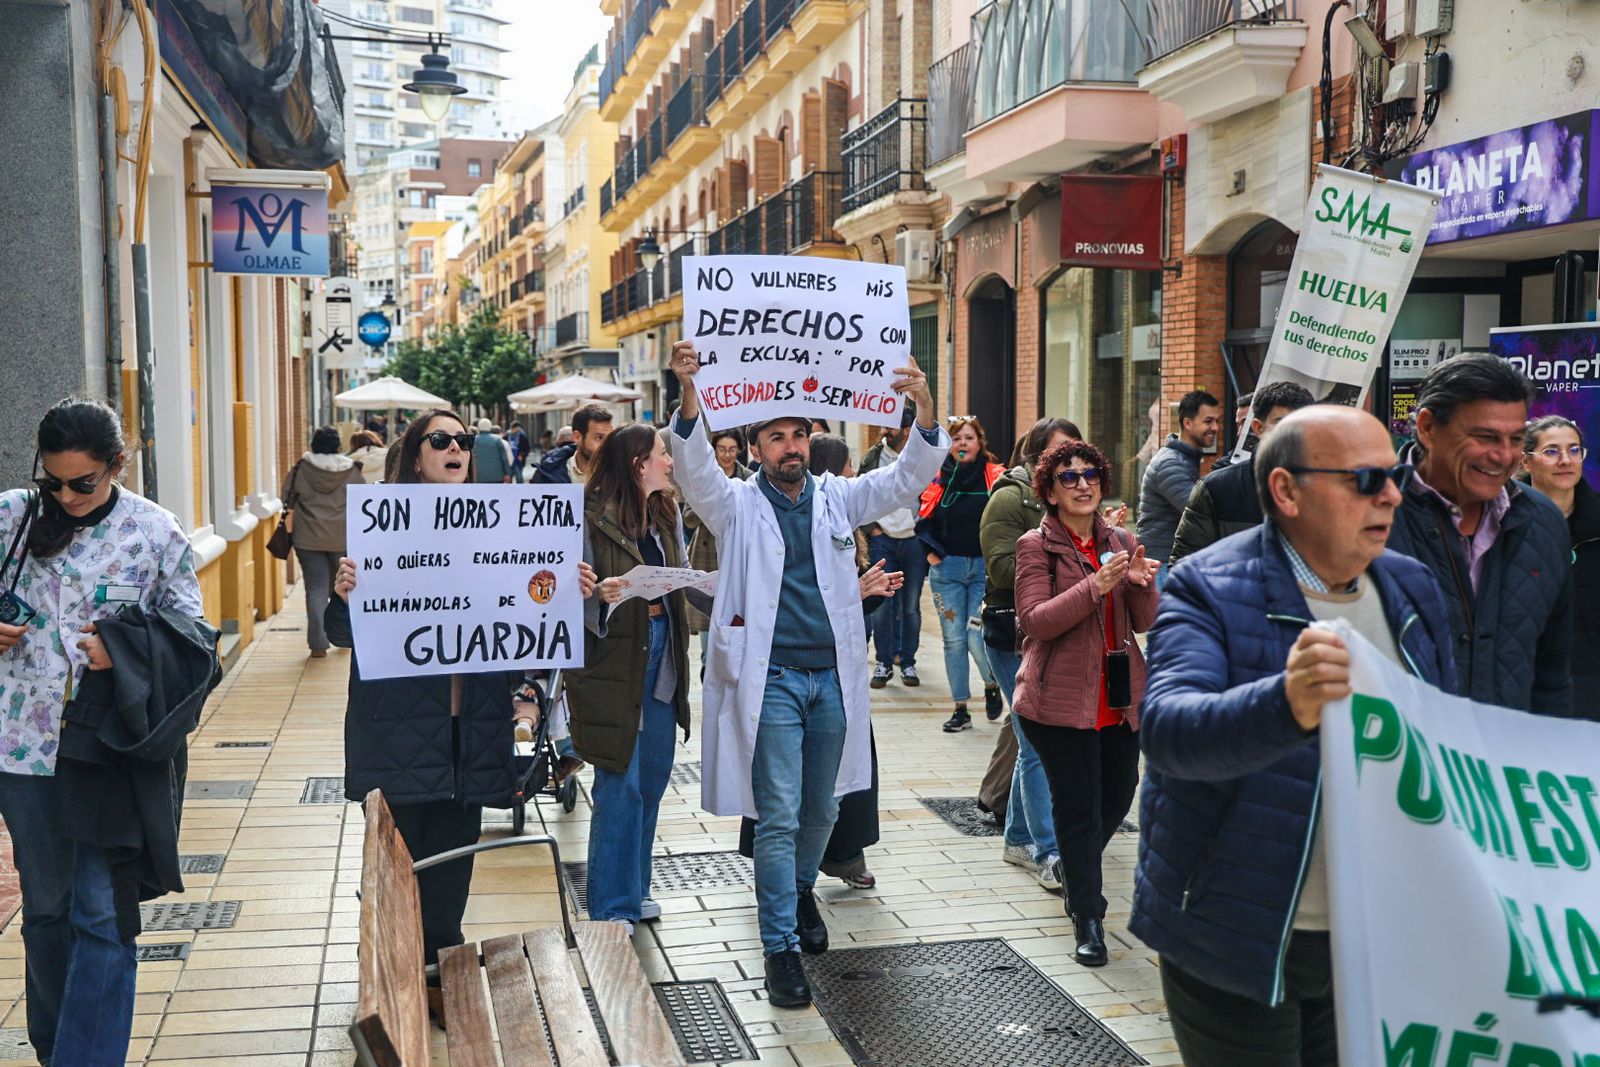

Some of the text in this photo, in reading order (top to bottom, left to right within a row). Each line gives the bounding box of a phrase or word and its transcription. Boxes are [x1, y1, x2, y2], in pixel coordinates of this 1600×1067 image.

[1416, 142, 1544, 197] PLANETA
[1315, 187, 1411, 240] SMA
[1451, 190, 1505, 213] VAPER
[1075, 242, 1144, 254] PRONOVIAS
[244, 256, 301, 270] OLMAE
[697, 267, 733, 292] NO
[751, 272, 837, 292] VULNERES
[1299, 270, 1387, 313] HUELVA
[695, 308, 906, 345] DERECHOS CON
[1289, 310, 1376, 345] Defendiendo
[1284, 329, 1368, 362] tus derechos
[698, 351, 718, 366] LA
[1546, 382, 1578, 392] VAPER
[361, 494, 582, 534] SON HORAS EXTRA,
[364, 556, 383, 570] NO
[473, 550, 564, 565] ENGAÑARNOS
[363, 591, 516, 613] LLAMÁNDOLAS DE
